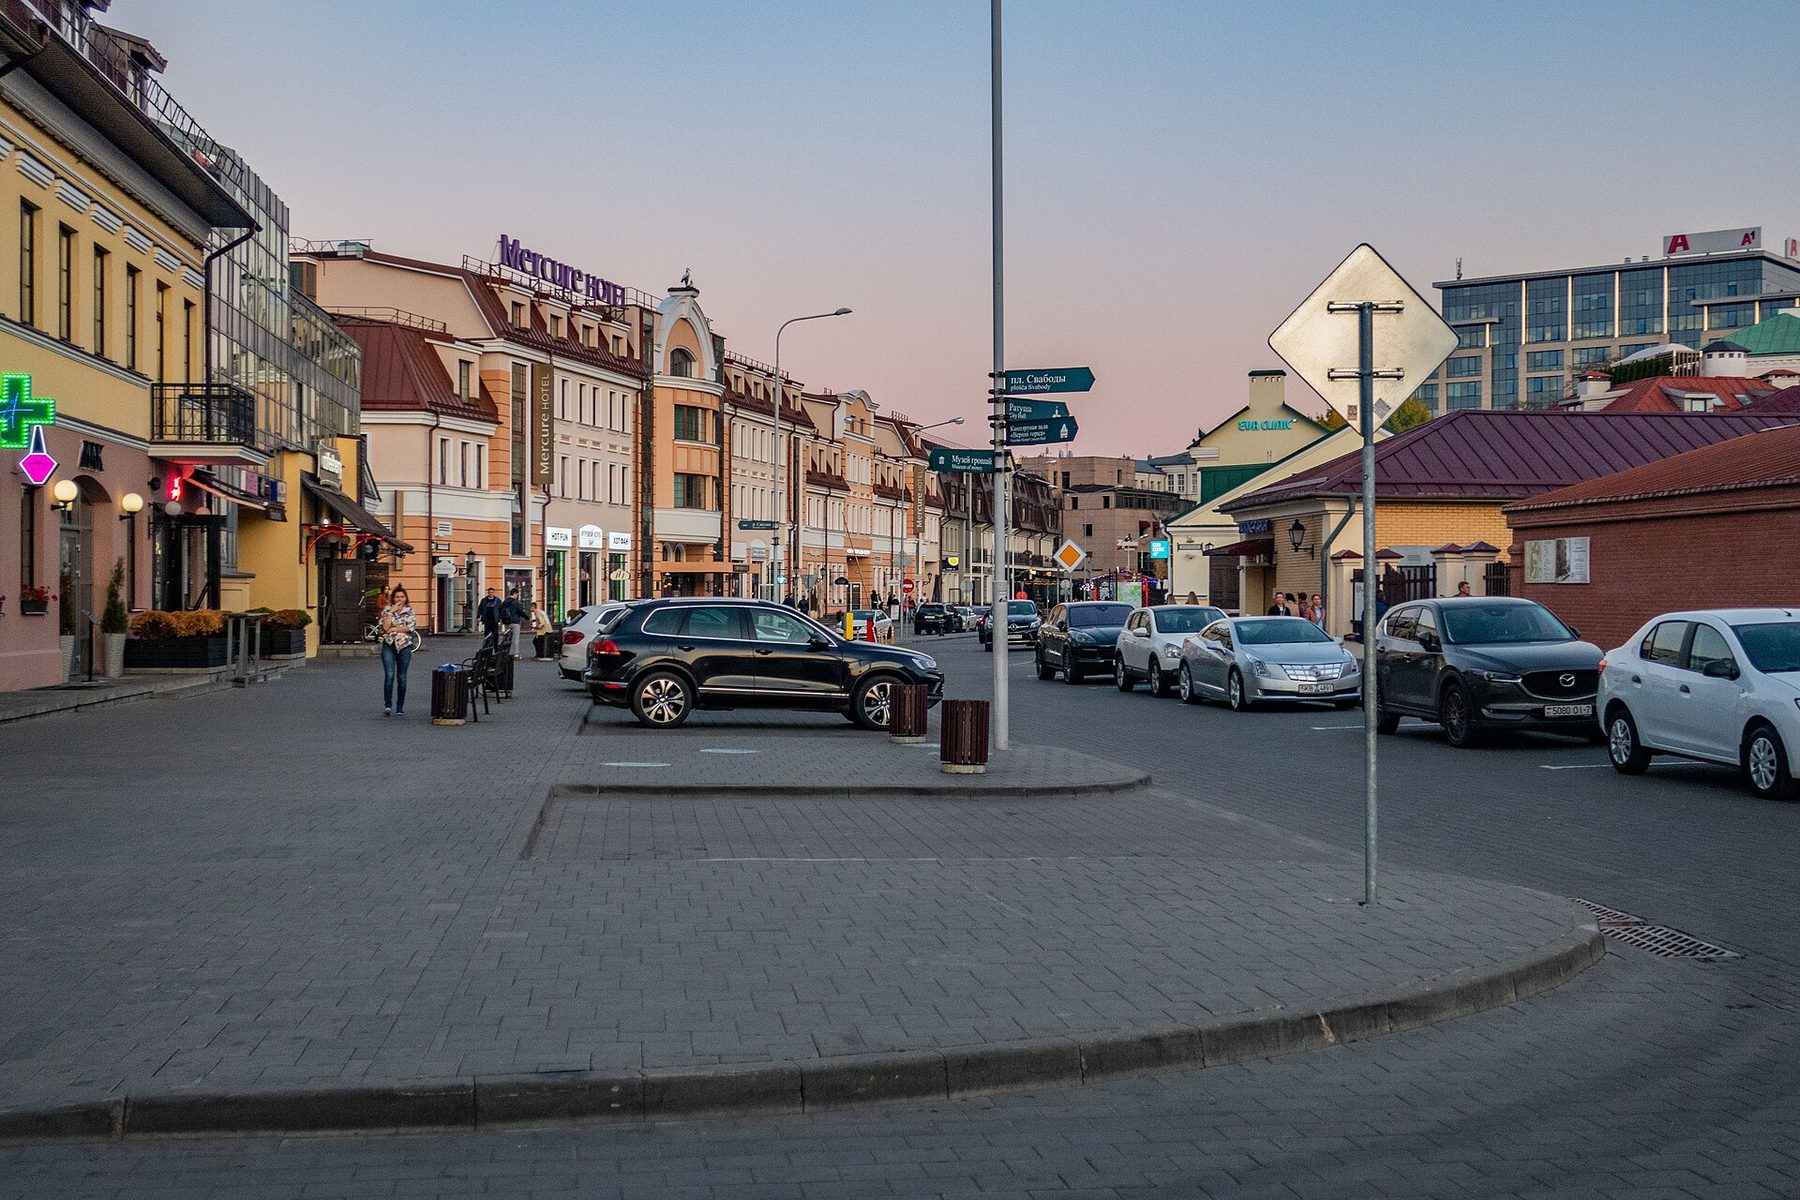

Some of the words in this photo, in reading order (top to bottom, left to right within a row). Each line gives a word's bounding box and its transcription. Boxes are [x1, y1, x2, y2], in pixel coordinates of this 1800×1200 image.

[500, 233, 584, 294] Mercure
[585, 273, 626, 309] HOTEL
[1026, 374, 1066, 384] Свабоды
[541, 373, 550, 410] HOTEL
[1009, 403, 1032, 414] Ратуша
[1239, 420, 1259, 430] EVA
[1262, 420, 1292, 430] CLINIC
[540, 413, 550, 475] Mercure
[952, 455, 970, 464] Музей
[1553, 706, 1571, 715] 5080
